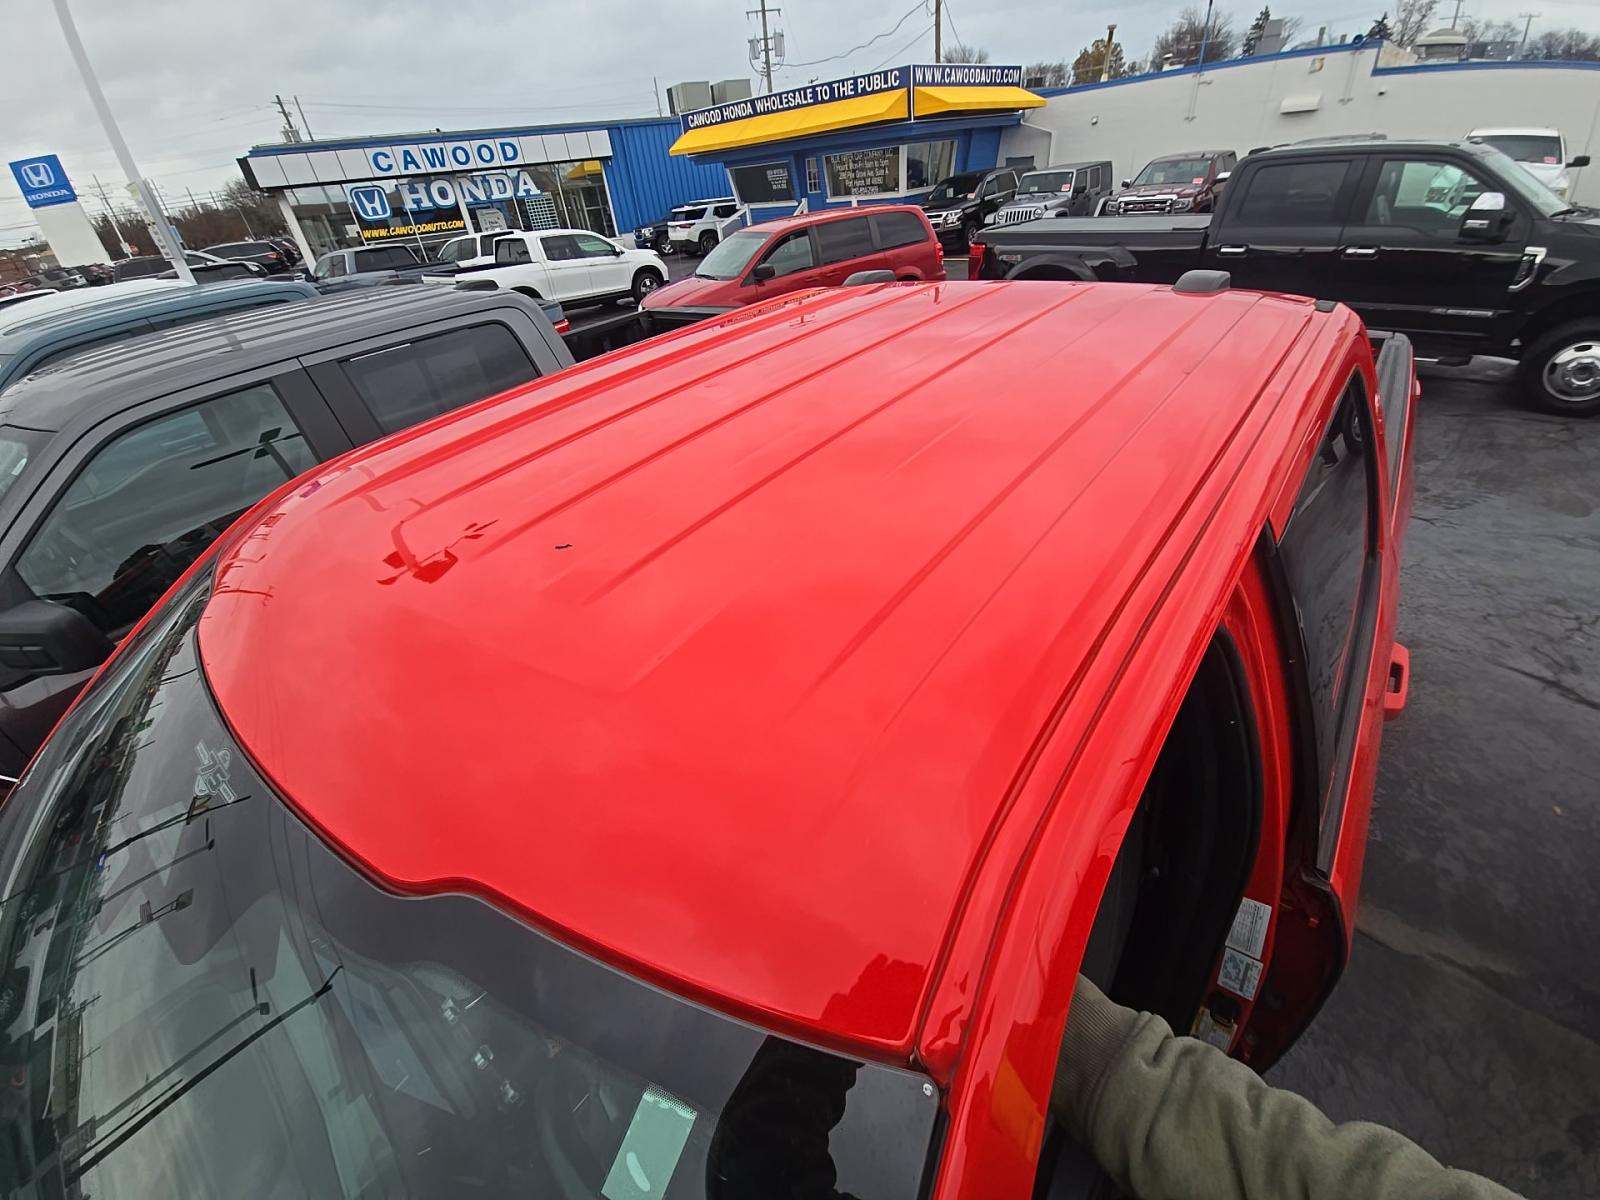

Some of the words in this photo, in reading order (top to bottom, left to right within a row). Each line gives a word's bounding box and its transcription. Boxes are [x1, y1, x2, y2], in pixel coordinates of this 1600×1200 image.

[915, 67, 1020, 84] WWW.CAWOODAUTO.COM
[688, 110, 721, 128] CAWOOD
[723, 105, 752, 121] HONDA
[754, 89, 814, 113] WHOLESALE
[815, 85, 830, 100] TO
[833, 79, 855, 98] THE
[857, 70, 900, 94] PUBLIC
[371, 142, 519, 172] CAWOOD
[26, 189, 71, 202] HONDA
[401, 170, 541, 210] HONDA
[362, 219, 465, 238] WWW.CAWOODAUTO.COM
